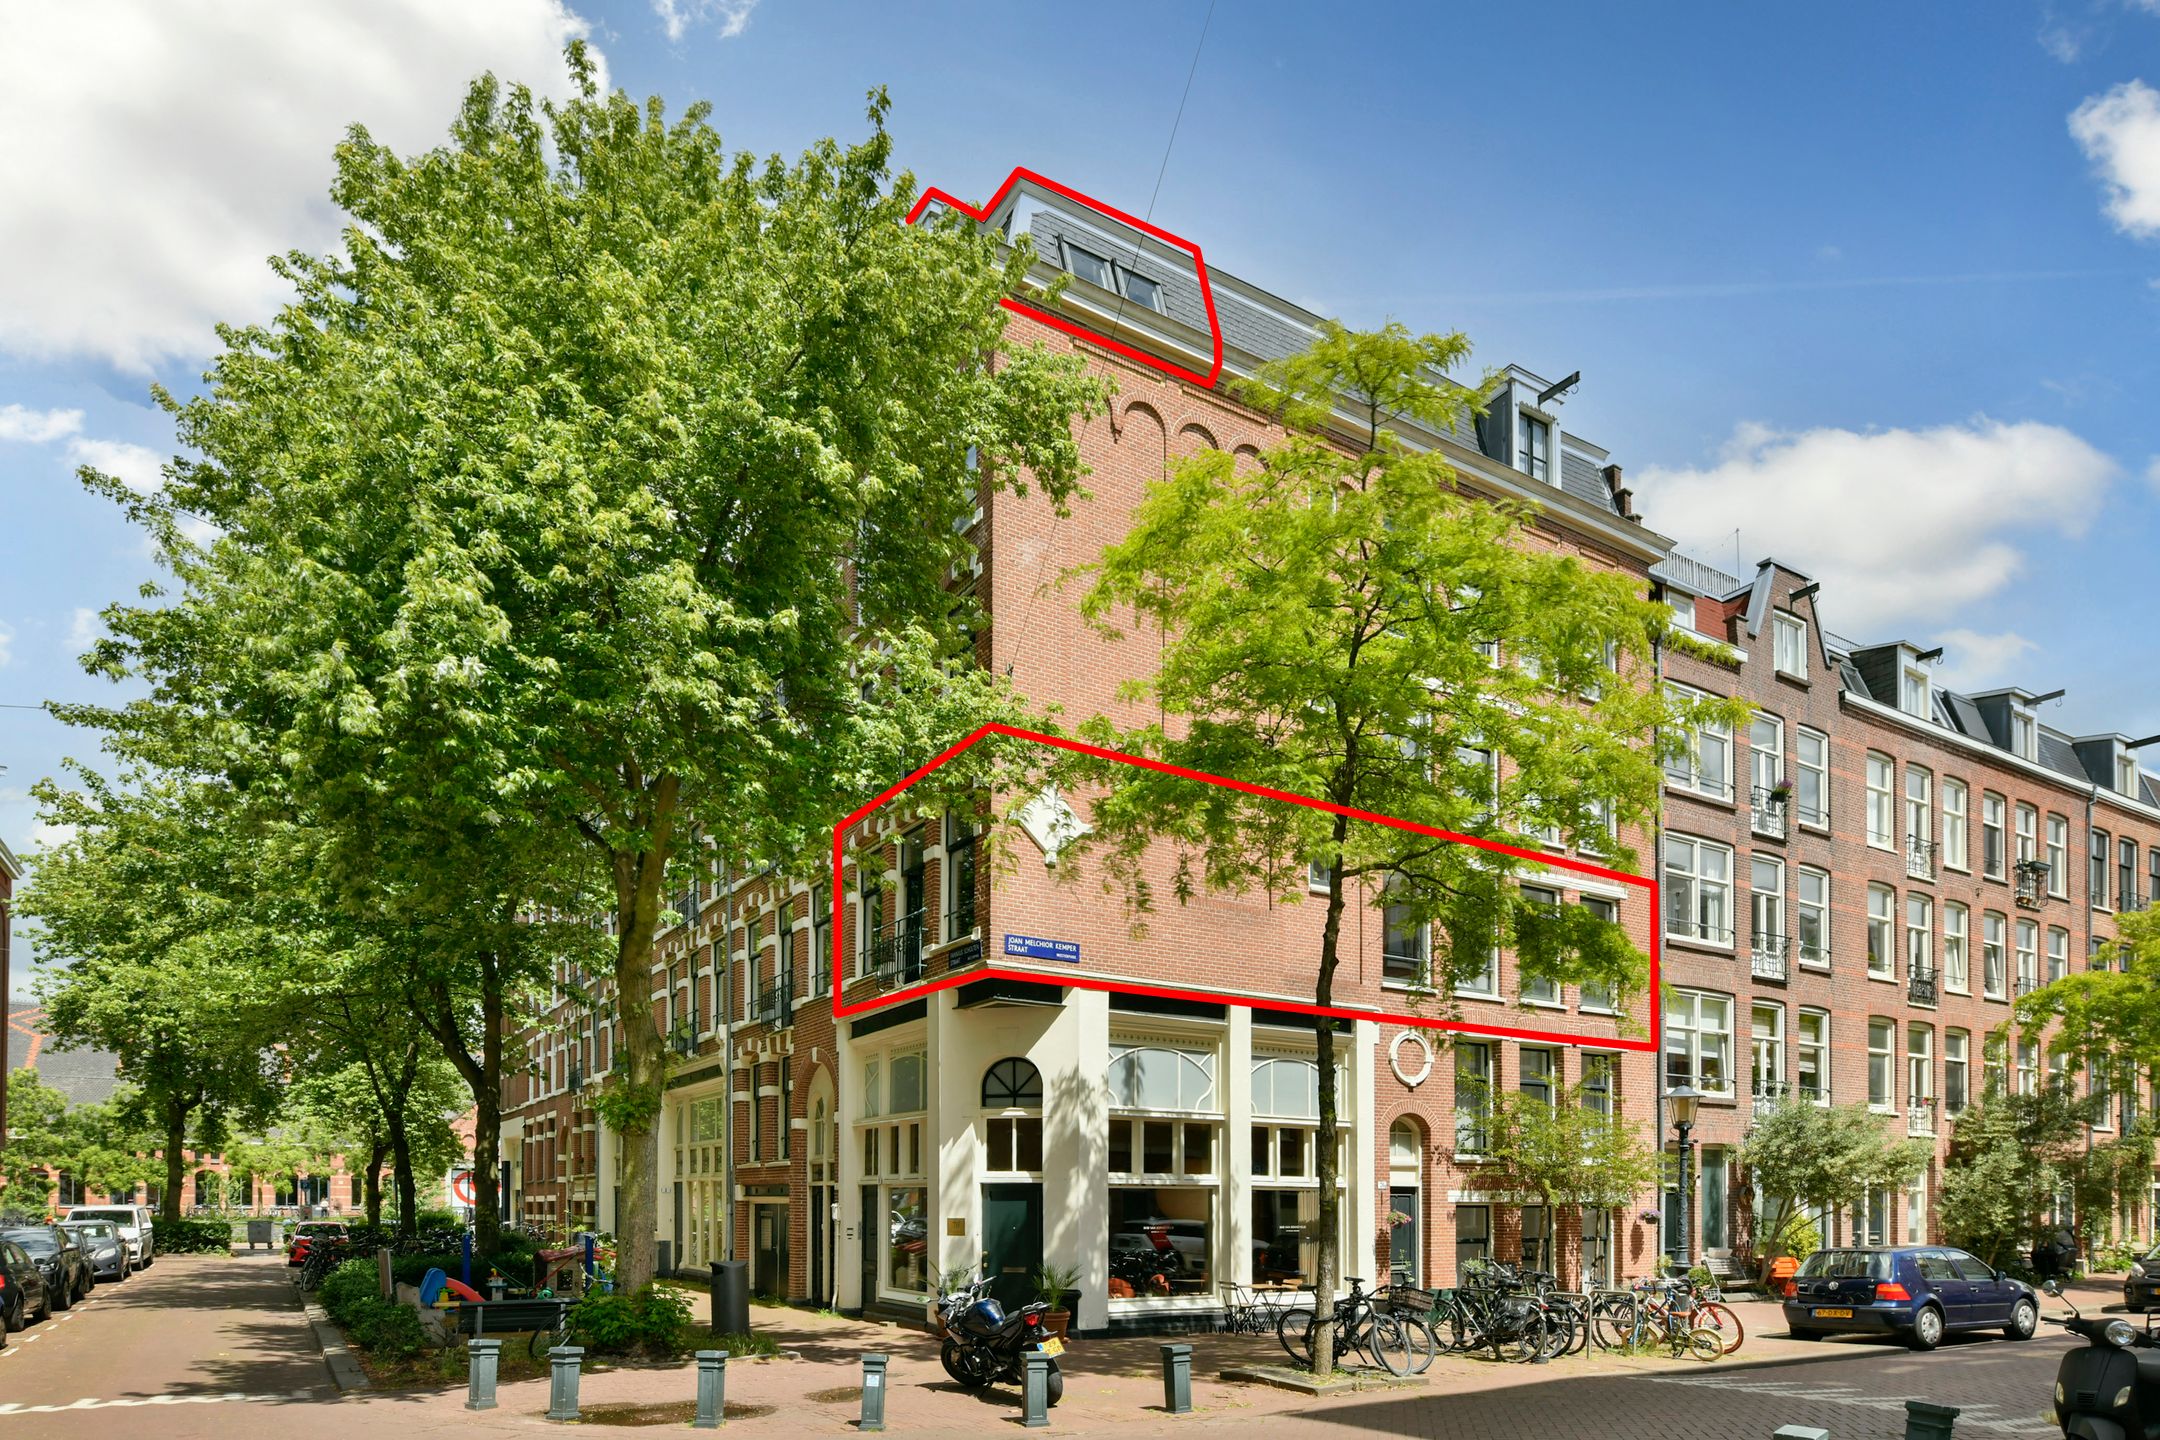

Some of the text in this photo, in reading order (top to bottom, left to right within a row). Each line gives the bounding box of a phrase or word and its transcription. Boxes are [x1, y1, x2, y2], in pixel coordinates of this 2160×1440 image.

[1007, 944, 1028, 952] STRAAT
[1008, 937, 1076, 951] JOAN MELCHIOR KEMPER
